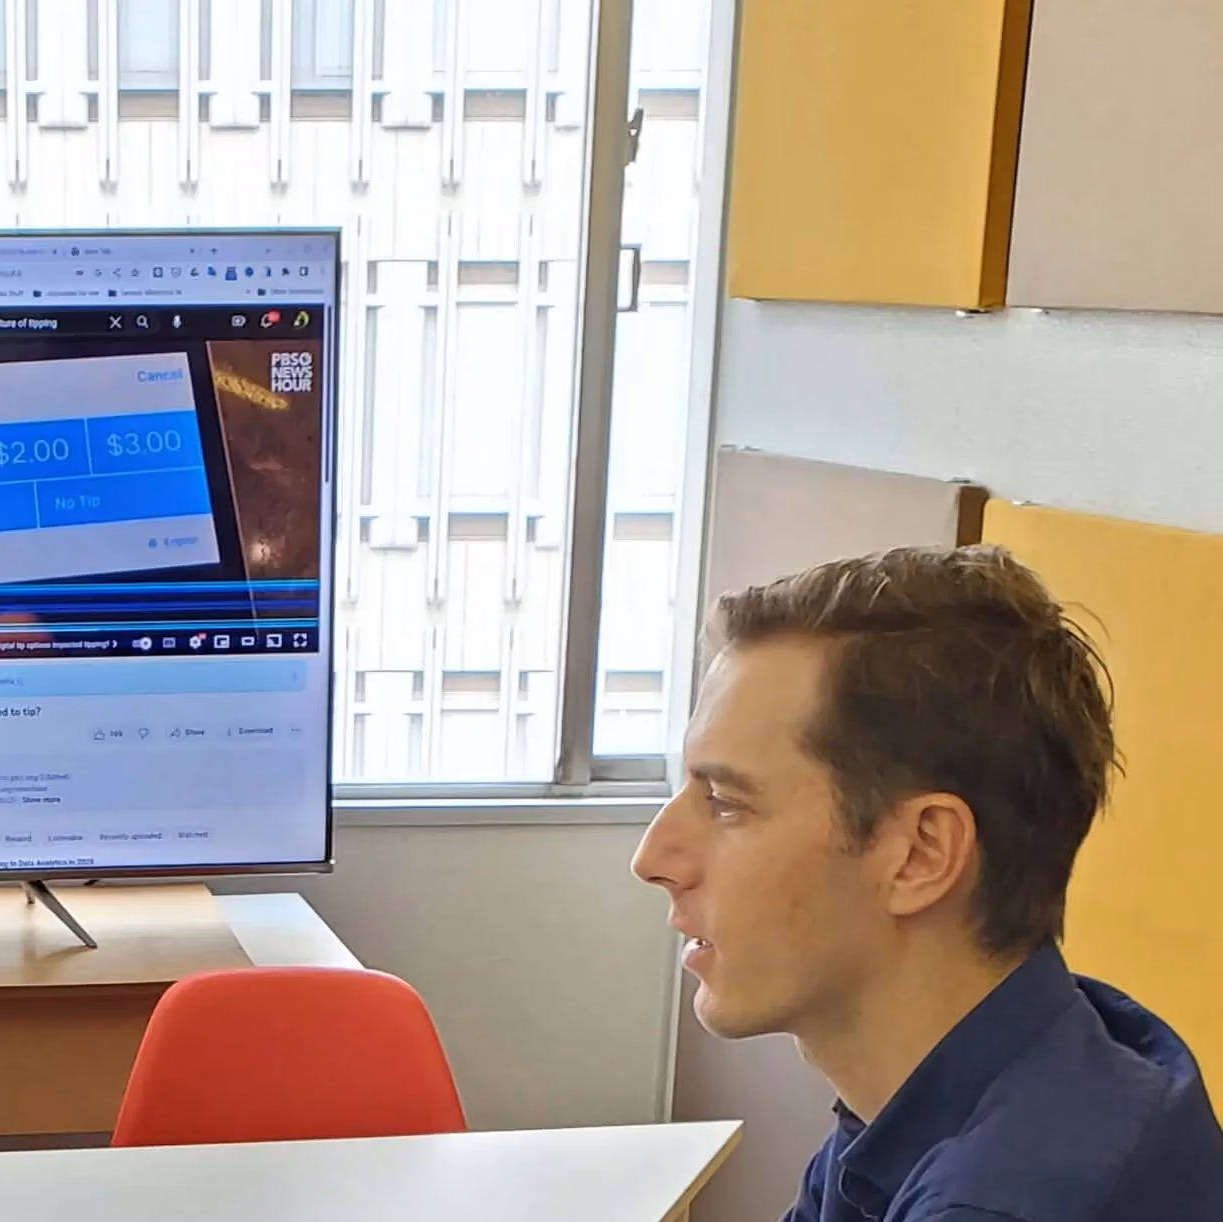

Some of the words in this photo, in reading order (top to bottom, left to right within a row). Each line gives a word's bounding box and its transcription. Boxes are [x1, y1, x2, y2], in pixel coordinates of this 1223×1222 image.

[18, 317, 28, 328] of
[28, 318, 58, 331] tipping
[136, 368, 184, 383] Cancel
[271, 367, 313, 379] NEWS
[271, 379, 312, 393] HOUR
[106, 429, 183, 458] $3.00
[54, 495, 76, 511] No
[79, 493, 101, 510] Tip
[10, 708, 21, 718] to
[23, 706, 41, 719] tip?
